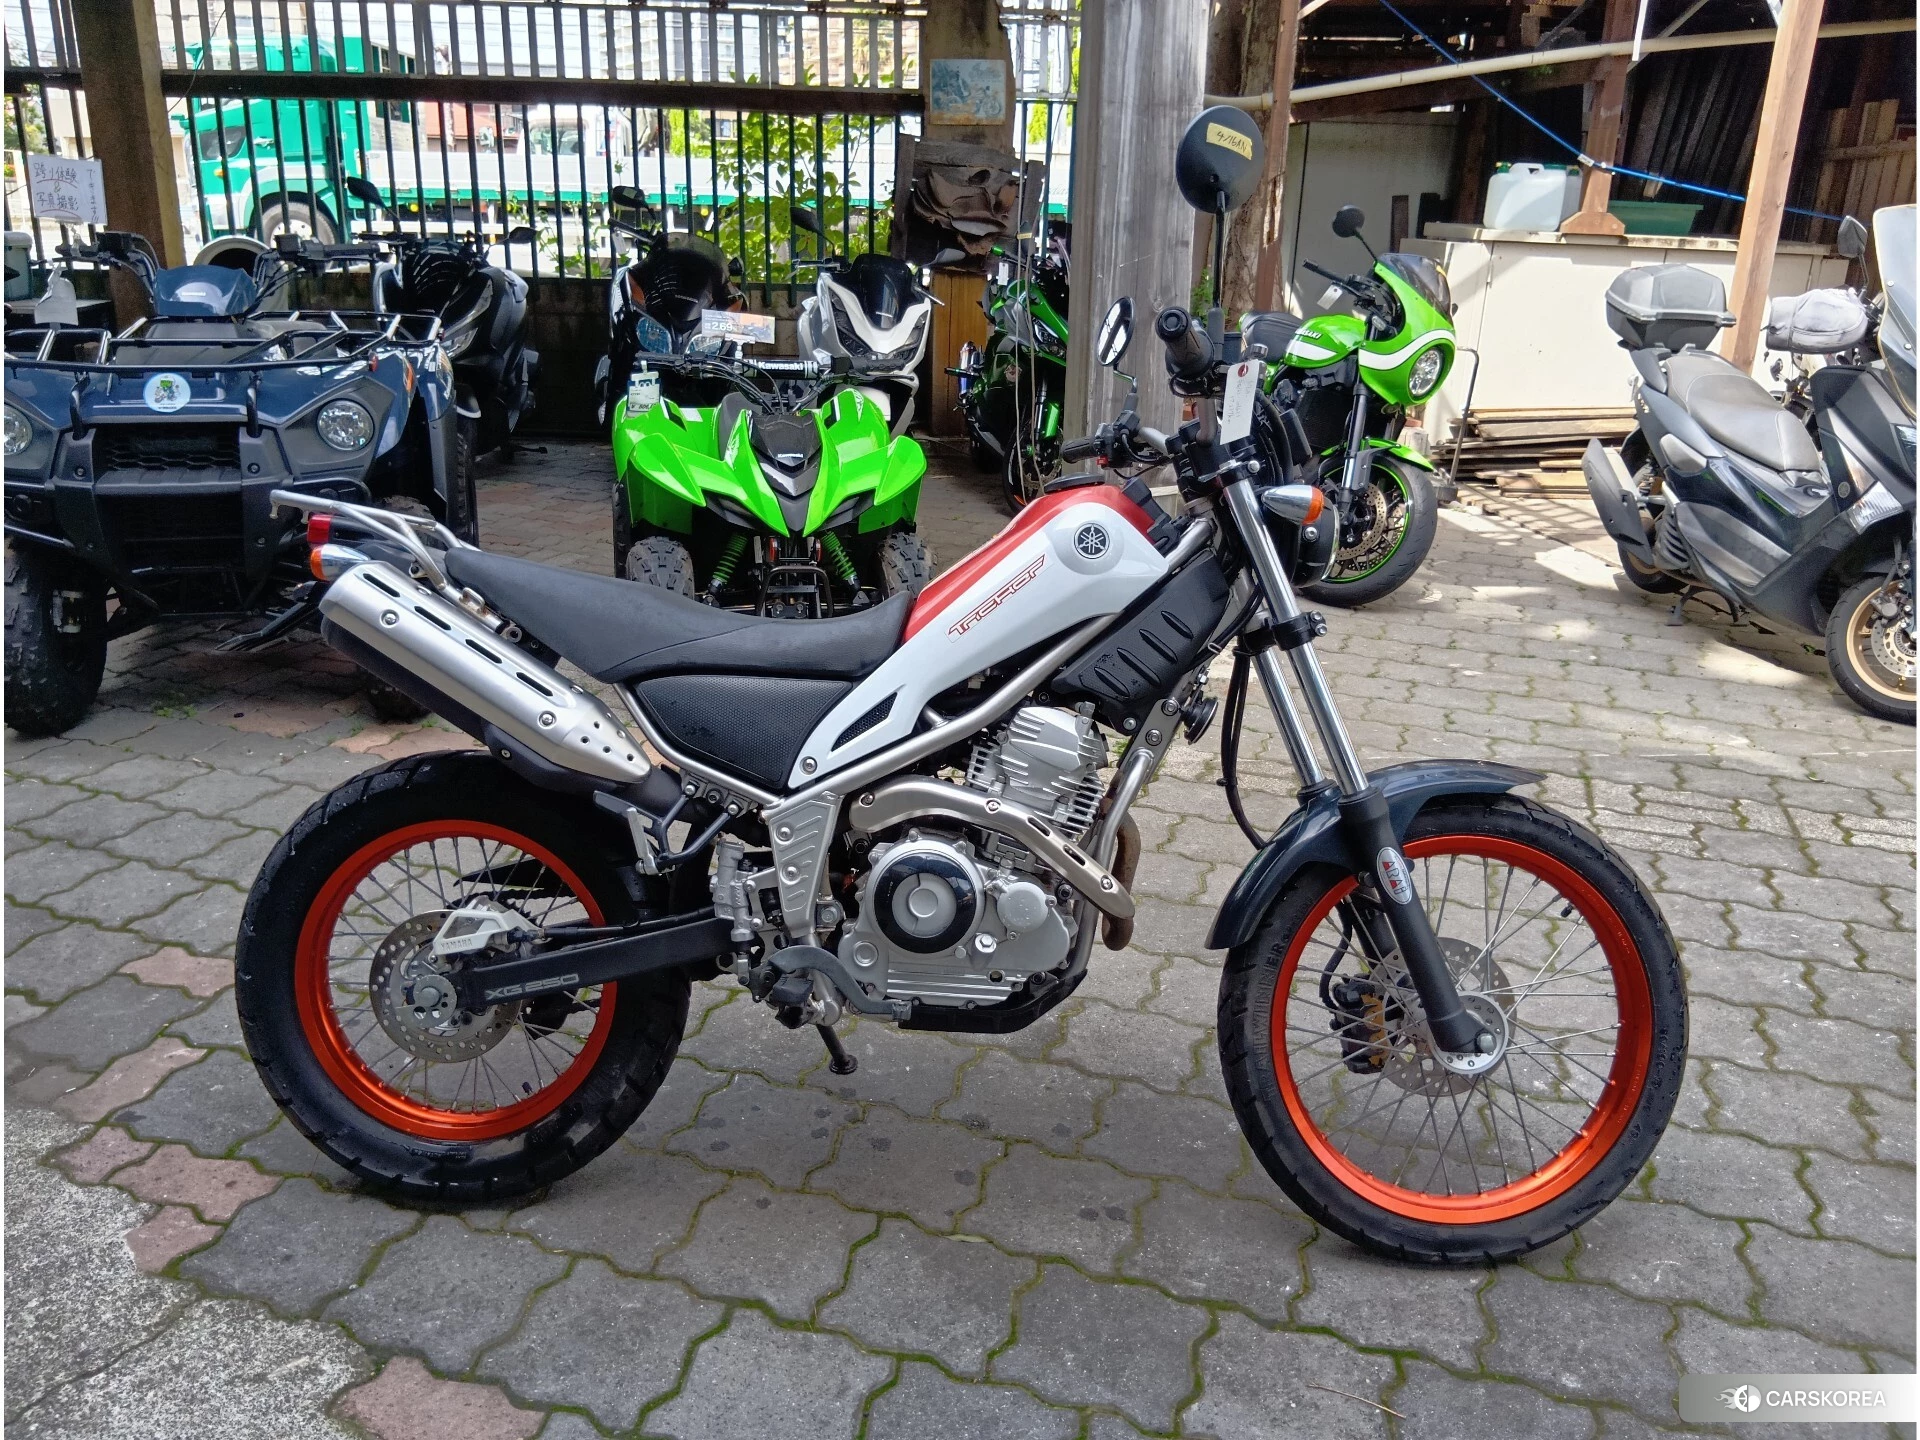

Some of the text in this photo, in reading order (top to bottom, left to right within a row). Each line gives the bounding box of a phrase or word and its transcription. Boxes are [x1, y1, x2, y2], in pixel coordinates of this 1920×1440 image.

[36, 192, 79, 211] 写真撮影
[758, 361, 804, 371] Kawasaki
[440, 937, 473, 950] YAMAHA
